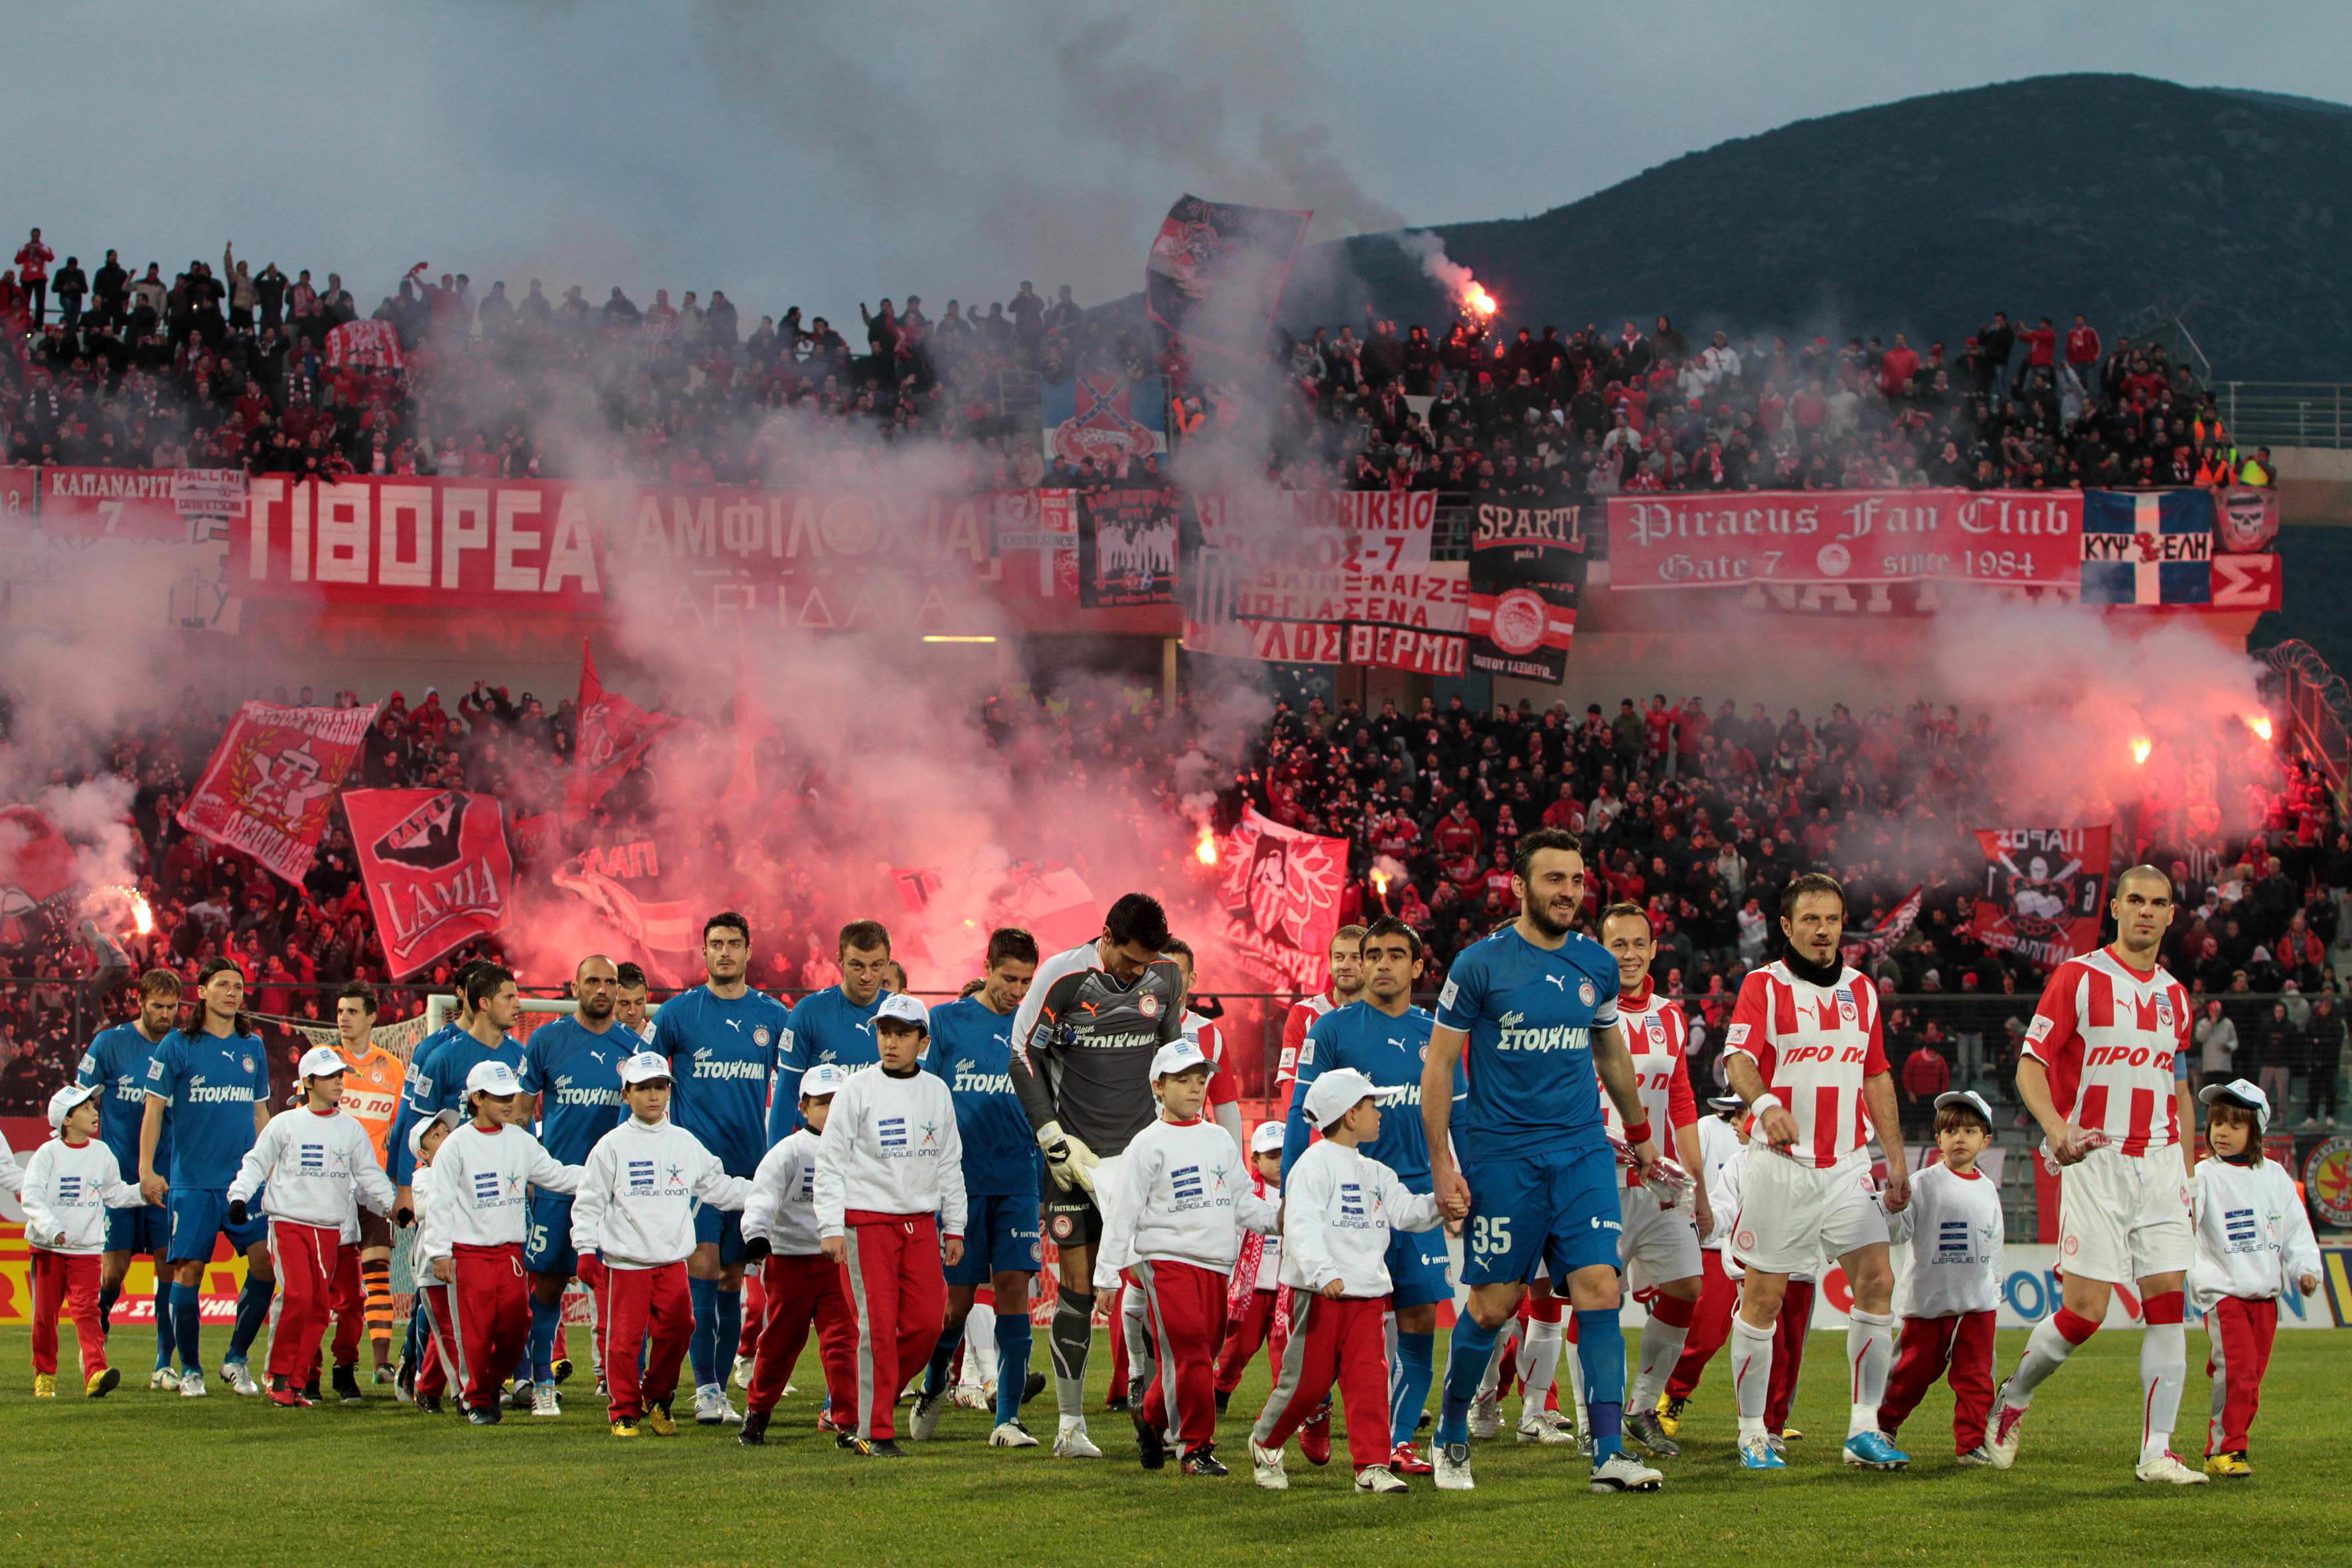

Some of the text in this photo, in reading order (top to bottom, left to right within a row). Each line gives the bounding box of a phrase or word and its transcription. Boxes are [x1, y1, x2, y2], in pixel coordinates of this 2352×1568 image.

[98, 499, 125, 532] 7
[1478, 503, 1581, 543] SPARTI
[1627, 497, 2070, 547] Piraeus Fan Club
[1658, 550, 2035, 582] Gate 7 since 1984
[339, 1095, 362, 1109] ΡΟ
[556, 1088, 622, 1107] ΣΤΟΙΧΗΜ
[1168, 1200, 1212, 1213] LEAGUE
[1332, 1220, 1371, 1229] LEAGUE
[1471, 1215, 1512, 1254] 35
[1932, 1256, 1976, 1265] LEAGUE
